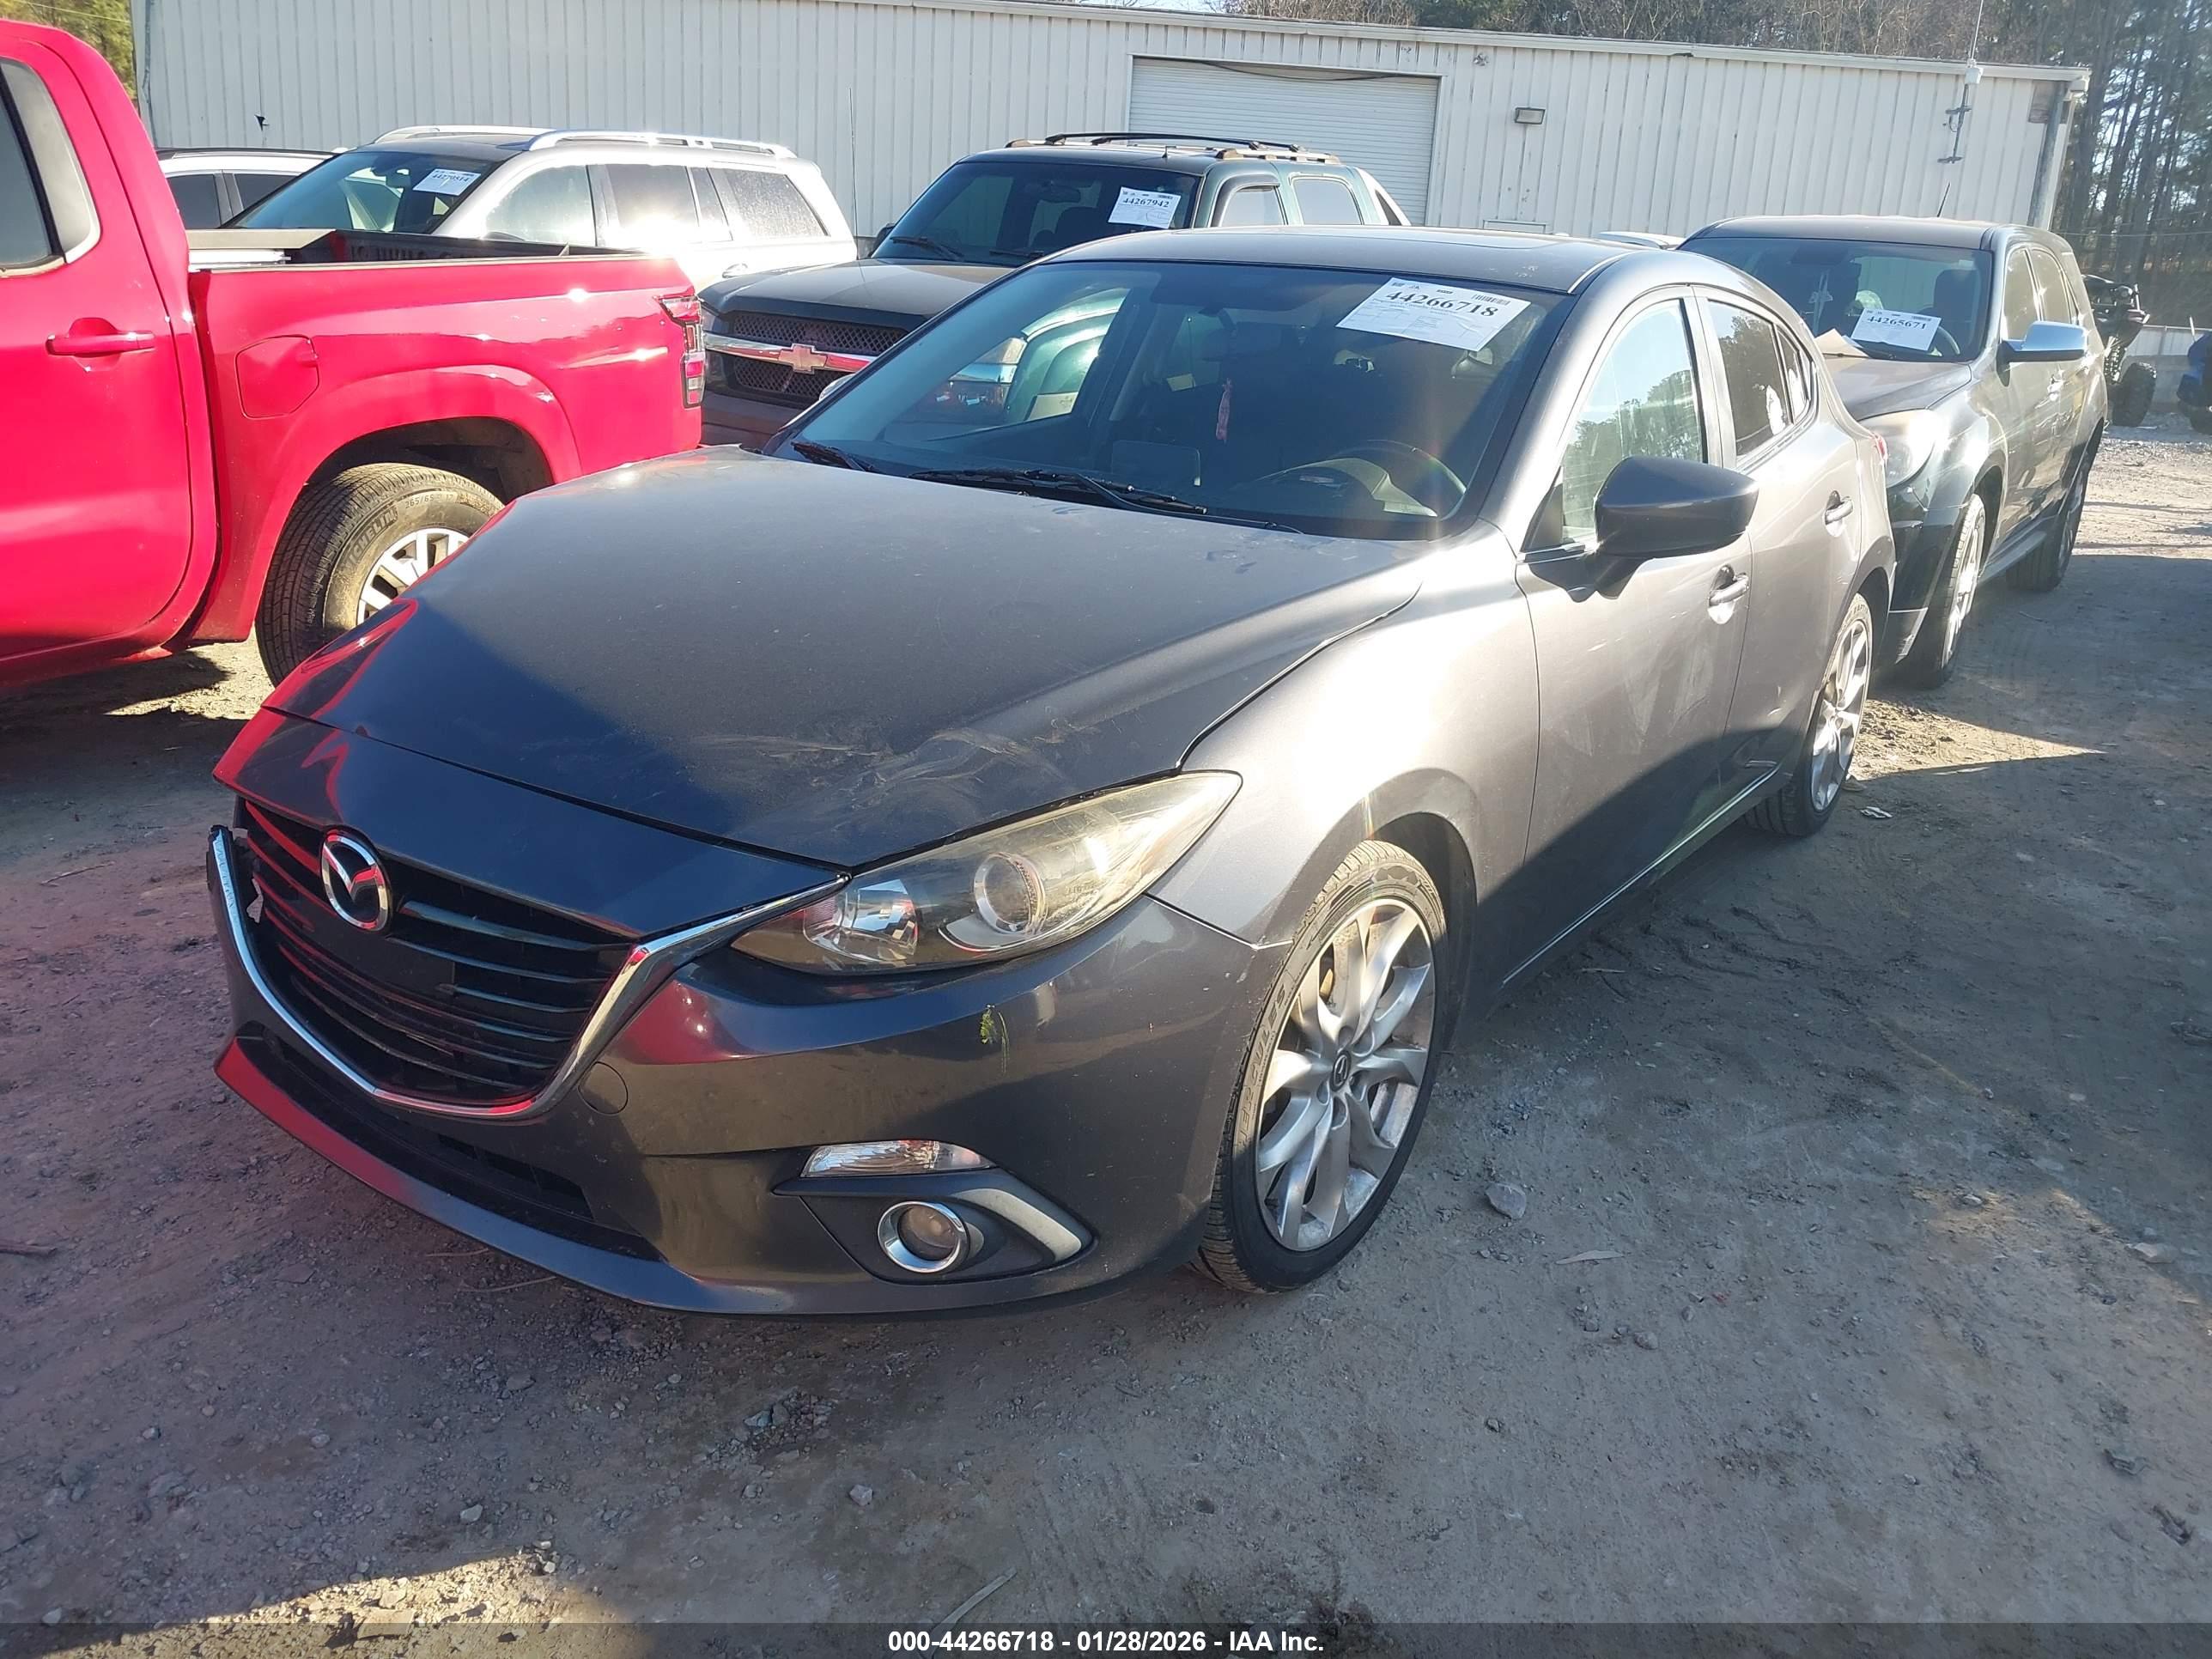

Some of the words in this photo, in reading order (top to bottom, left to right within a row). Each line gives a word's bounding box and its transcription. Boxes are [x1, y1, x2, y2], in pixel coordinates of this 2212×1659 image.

[1122, 198, 1170, 208] 44267942
[1385, 290, 1499, 317] 44266718
[1866, 315, 1927, 330] 44265671
